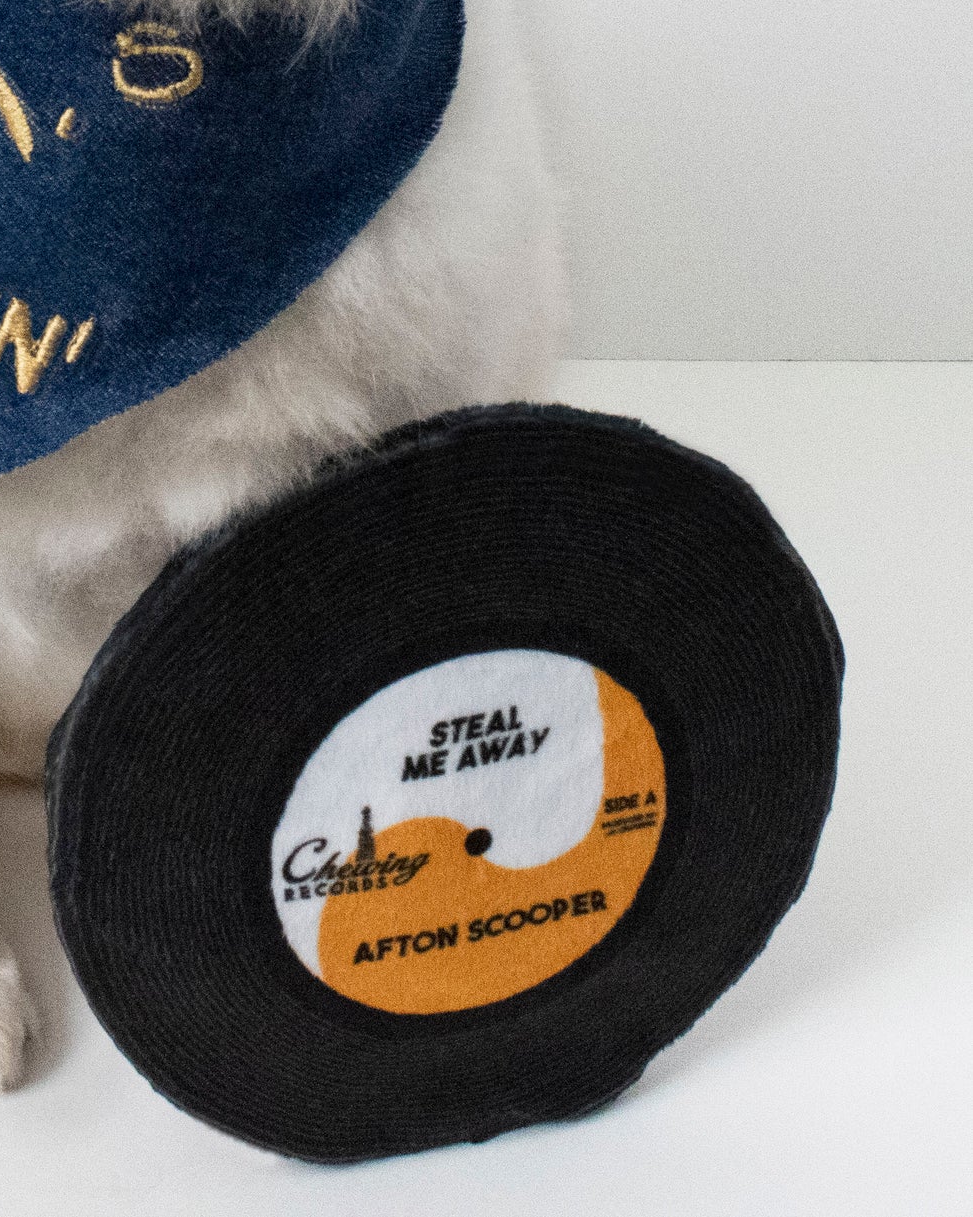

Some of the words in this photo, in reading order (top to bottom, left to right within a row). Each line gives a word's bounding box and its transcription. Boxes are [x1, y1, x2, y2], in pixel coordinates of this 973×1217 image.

[429, 704, 523, 748] STEAL
[401, 749, 449, 782] ME
[456, 727, 551, 772] AWAY
[604, 793, 639, 814] SIDE
[644, 788, 657, 805] A
[282, 837, 430, 886] Chewing
[284, 875, 388, 902] RECORDS
[353, 923, 459, 965] AFTON
[468, 889, 607, 942] SCOOPER
